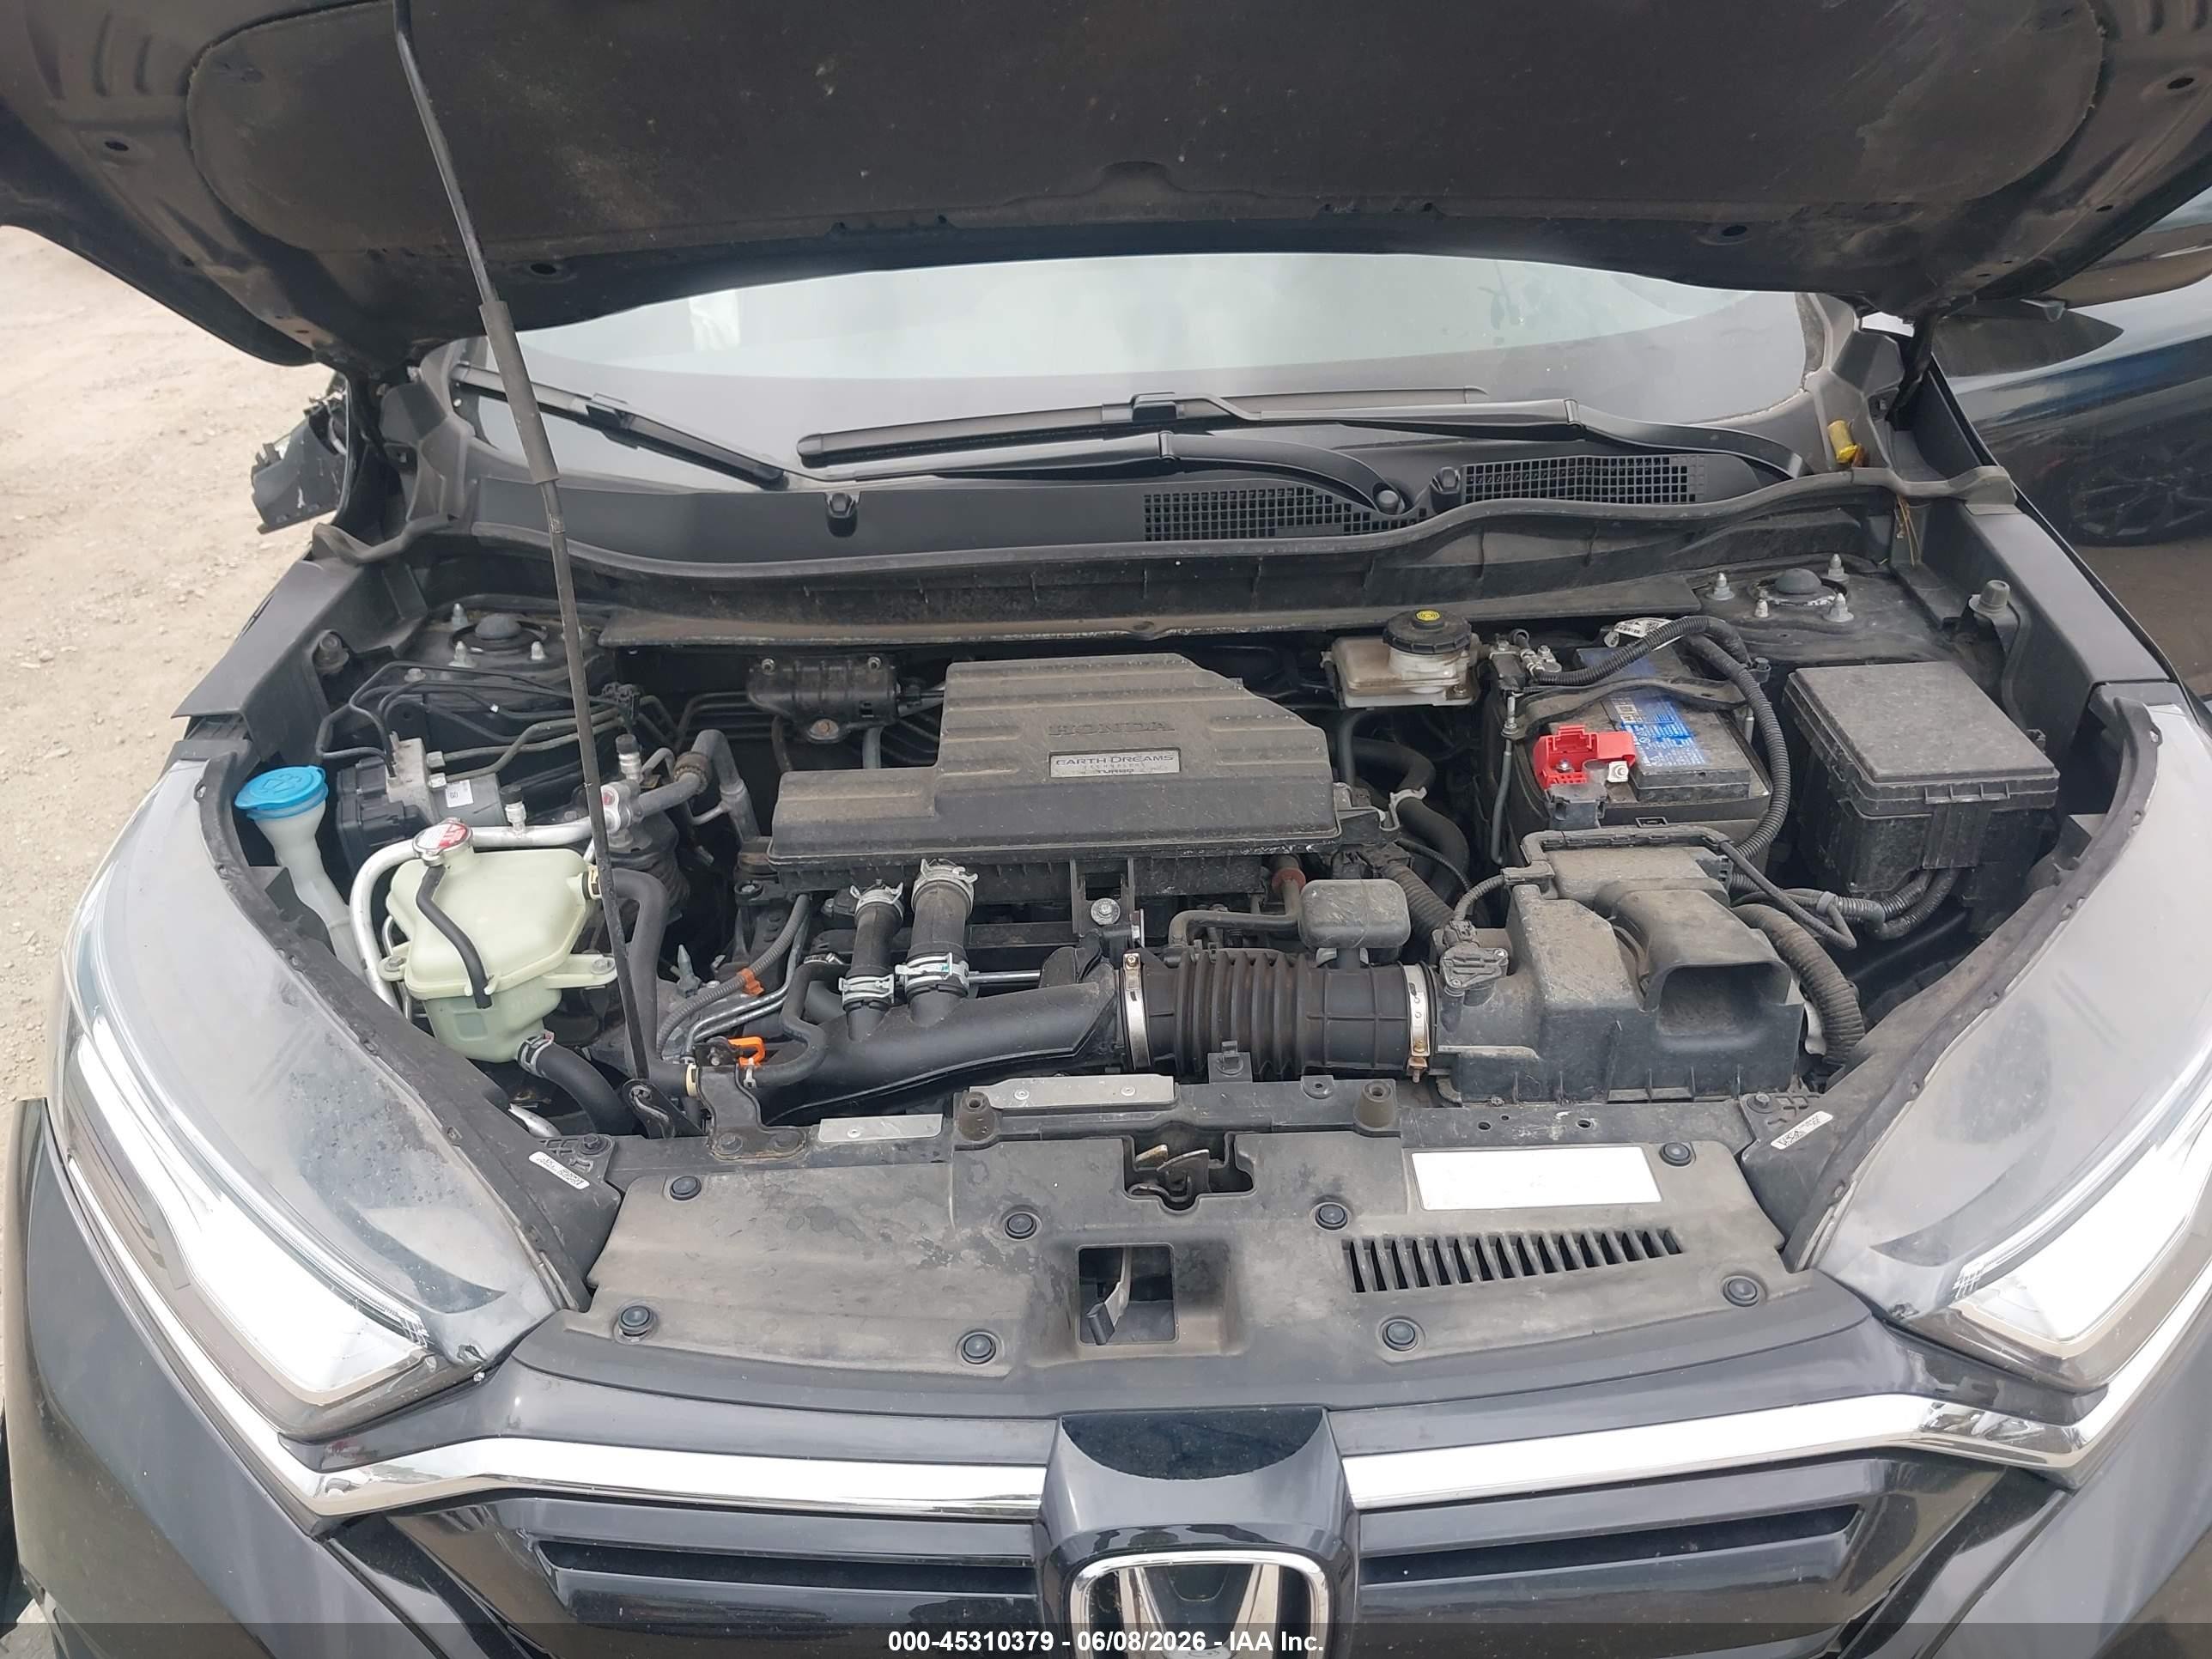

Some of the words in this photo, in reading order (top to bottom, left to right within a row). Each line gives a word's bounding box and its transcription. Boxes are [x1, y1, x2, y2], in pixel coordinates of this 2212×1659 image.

[1048, 720, 1176, 737] HONDA
[1056, 757, 1106, 766] EARTH
[1111, 755, 1174, 763] DREAMS
